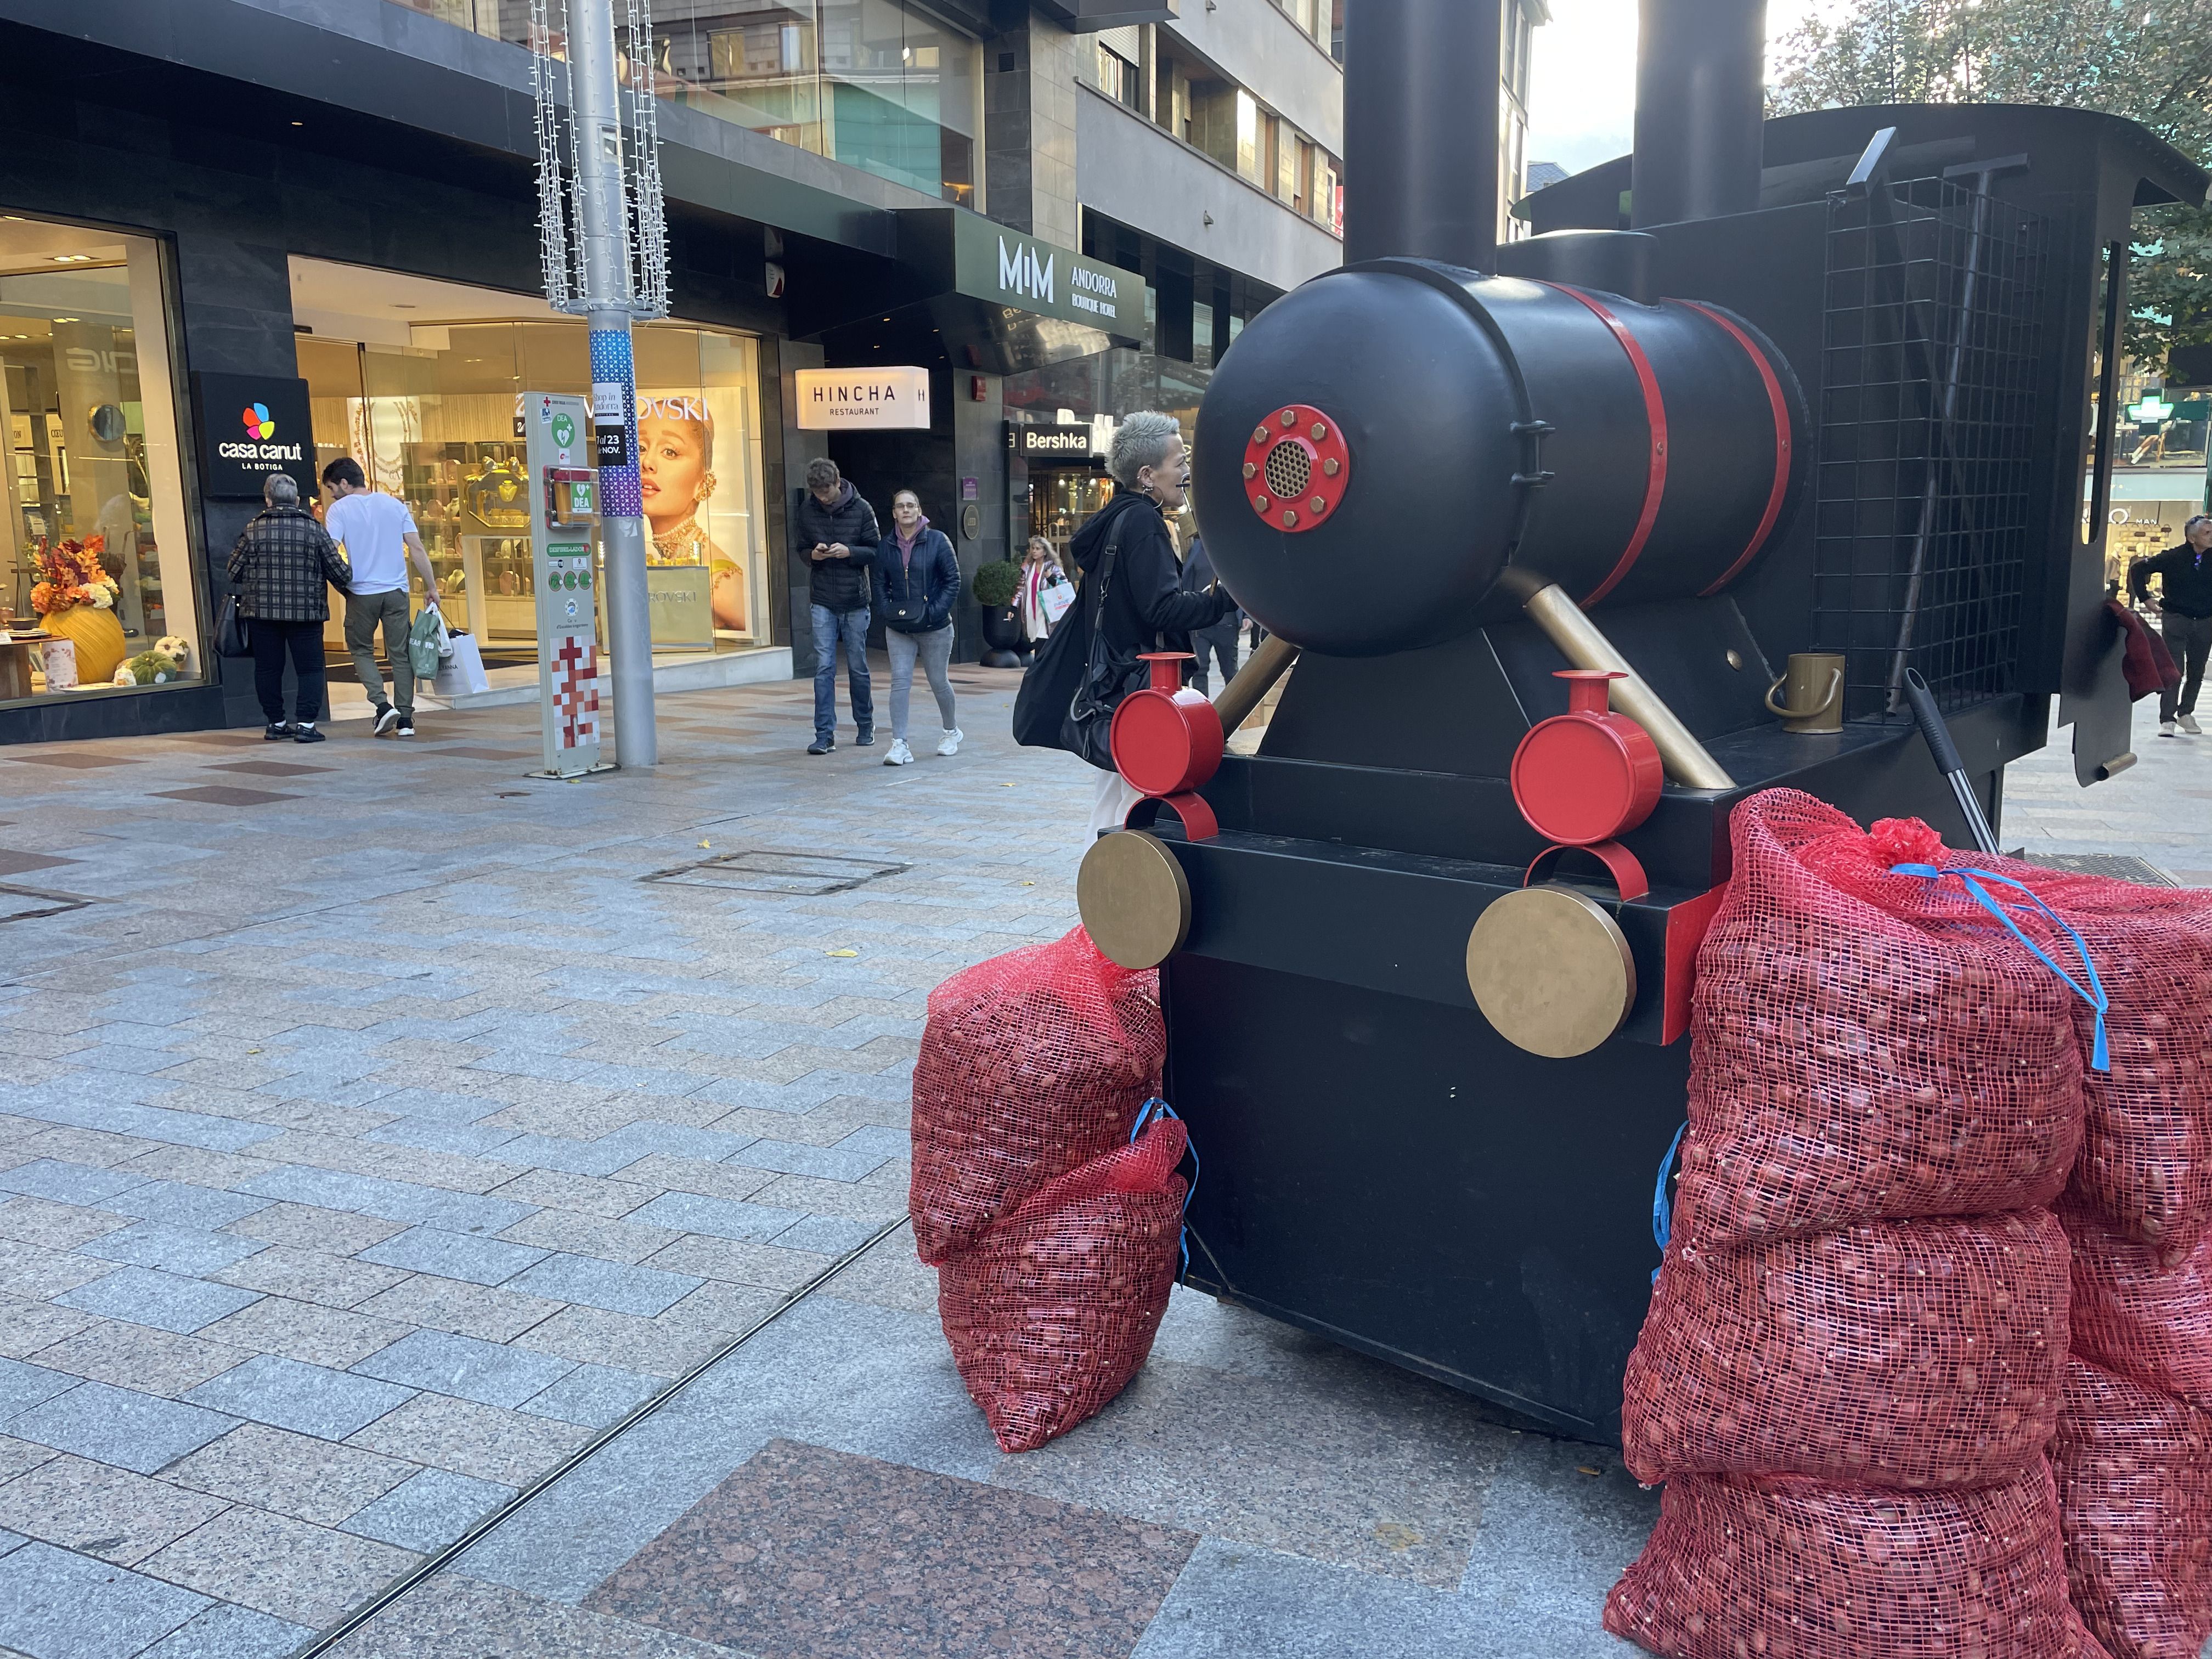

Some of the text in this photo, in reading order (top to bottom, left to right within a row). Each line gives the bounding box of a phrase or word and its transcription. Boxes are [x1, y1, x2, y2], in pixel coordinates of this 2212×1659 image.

[1071, 266, 1117, 299] ANDORRA
[1071, 293, 1117, 318] BOUTIQUE HOTEL
[608, 392, 616, 400] in
[813, 385, 896, 402] HINCHA
[637, 396, 709, 422] OVSKI
[829, 408, 879, 416] RESTAURANT
[600, 435, 606, 444] al
[607, 435, 619, 444] 23
[1026, 432, 1087, 449] Bershka
[219, 442, 302, 460] casa canut
[574, 497, 589, 507] DEA
[648, 591, 696, 603] ROVSKI
